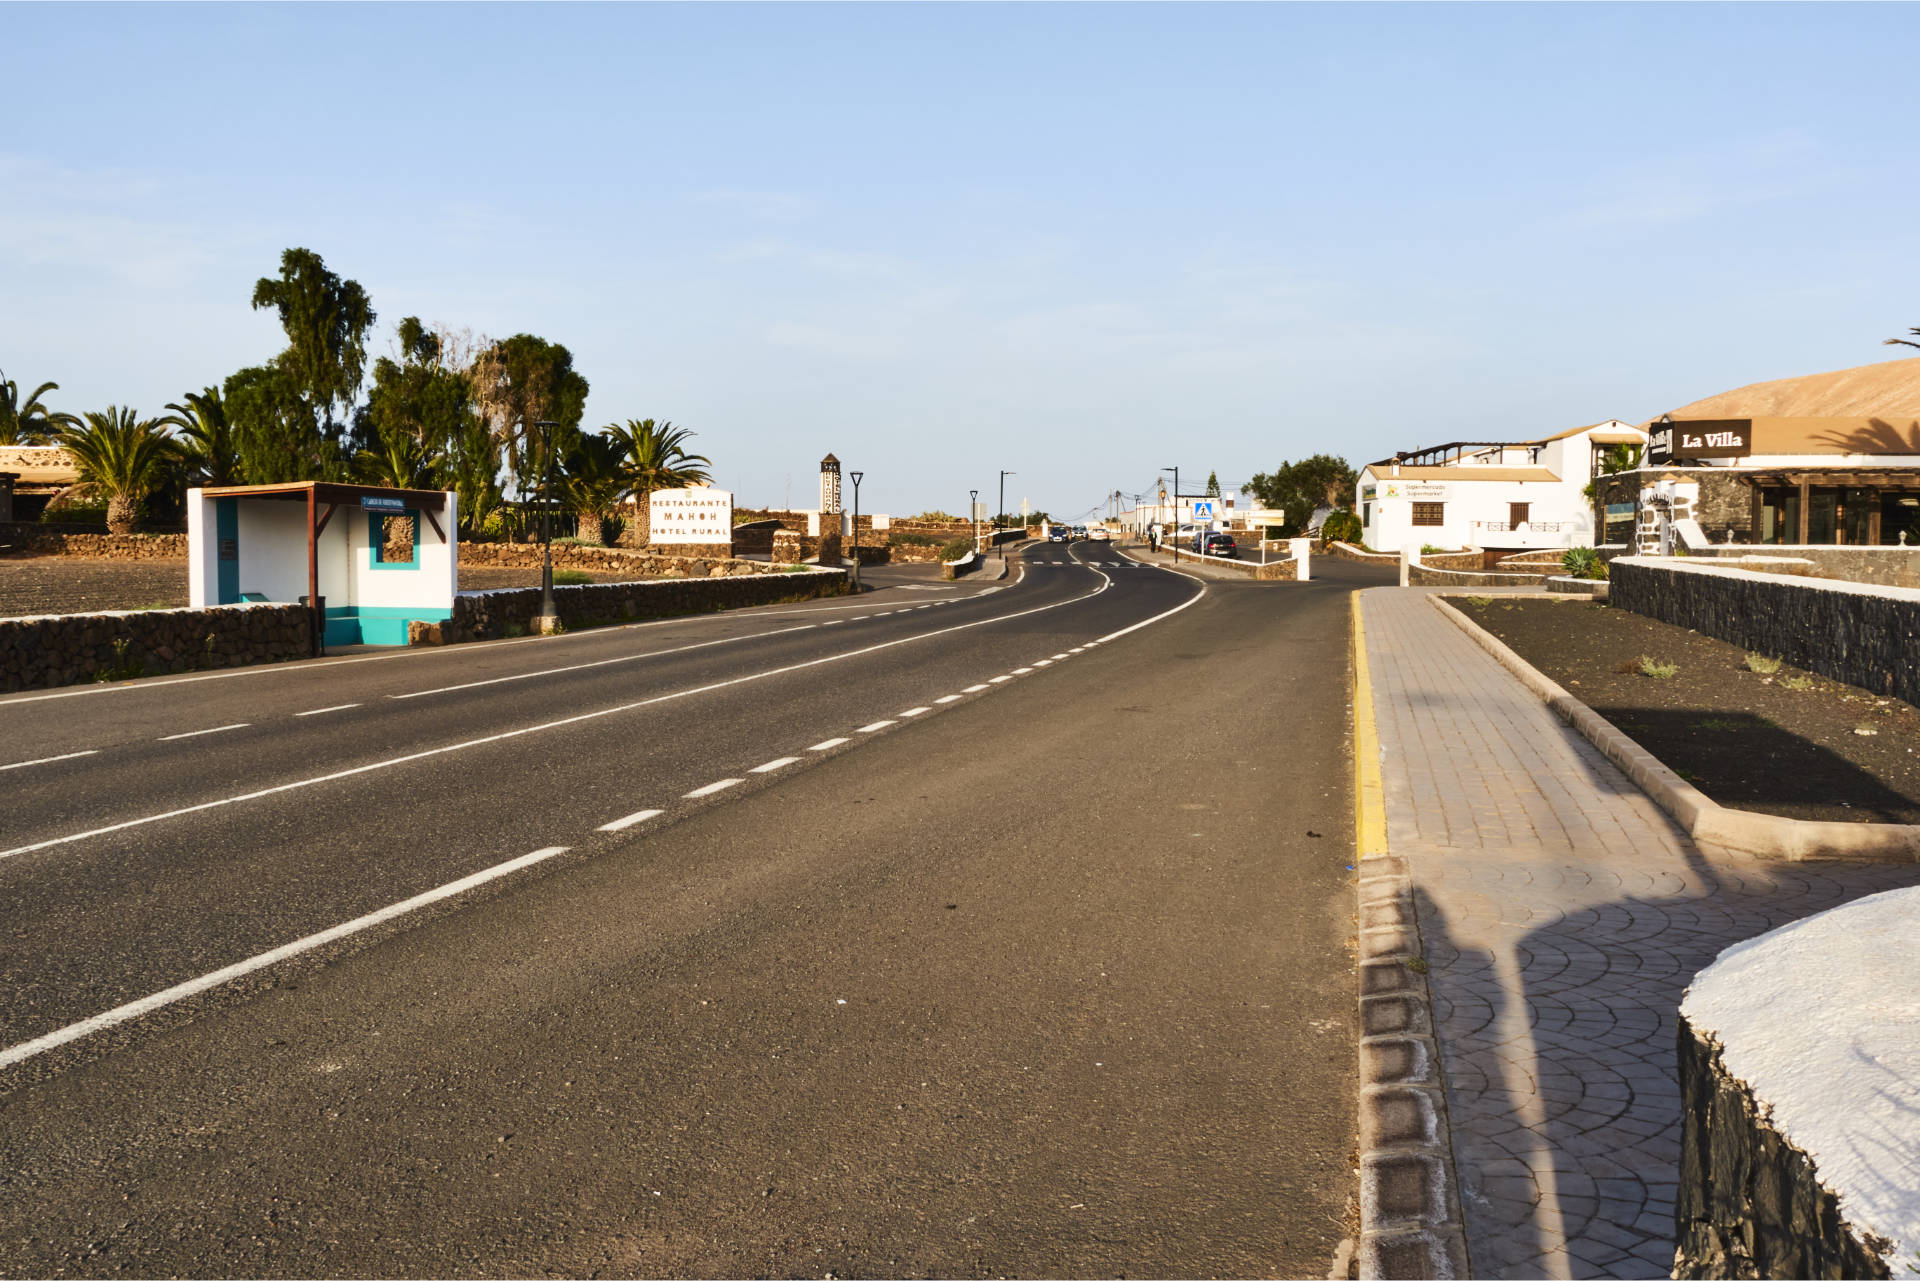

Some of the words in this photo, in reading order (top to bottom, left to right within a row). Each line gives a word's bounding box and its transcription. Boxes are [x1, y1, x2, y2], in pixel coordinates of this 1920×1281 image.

[1682, 434, 1702, 448] La
[1705, 431, 1743, 448] Villa
[664, 512, 716, 520] MAHOH
